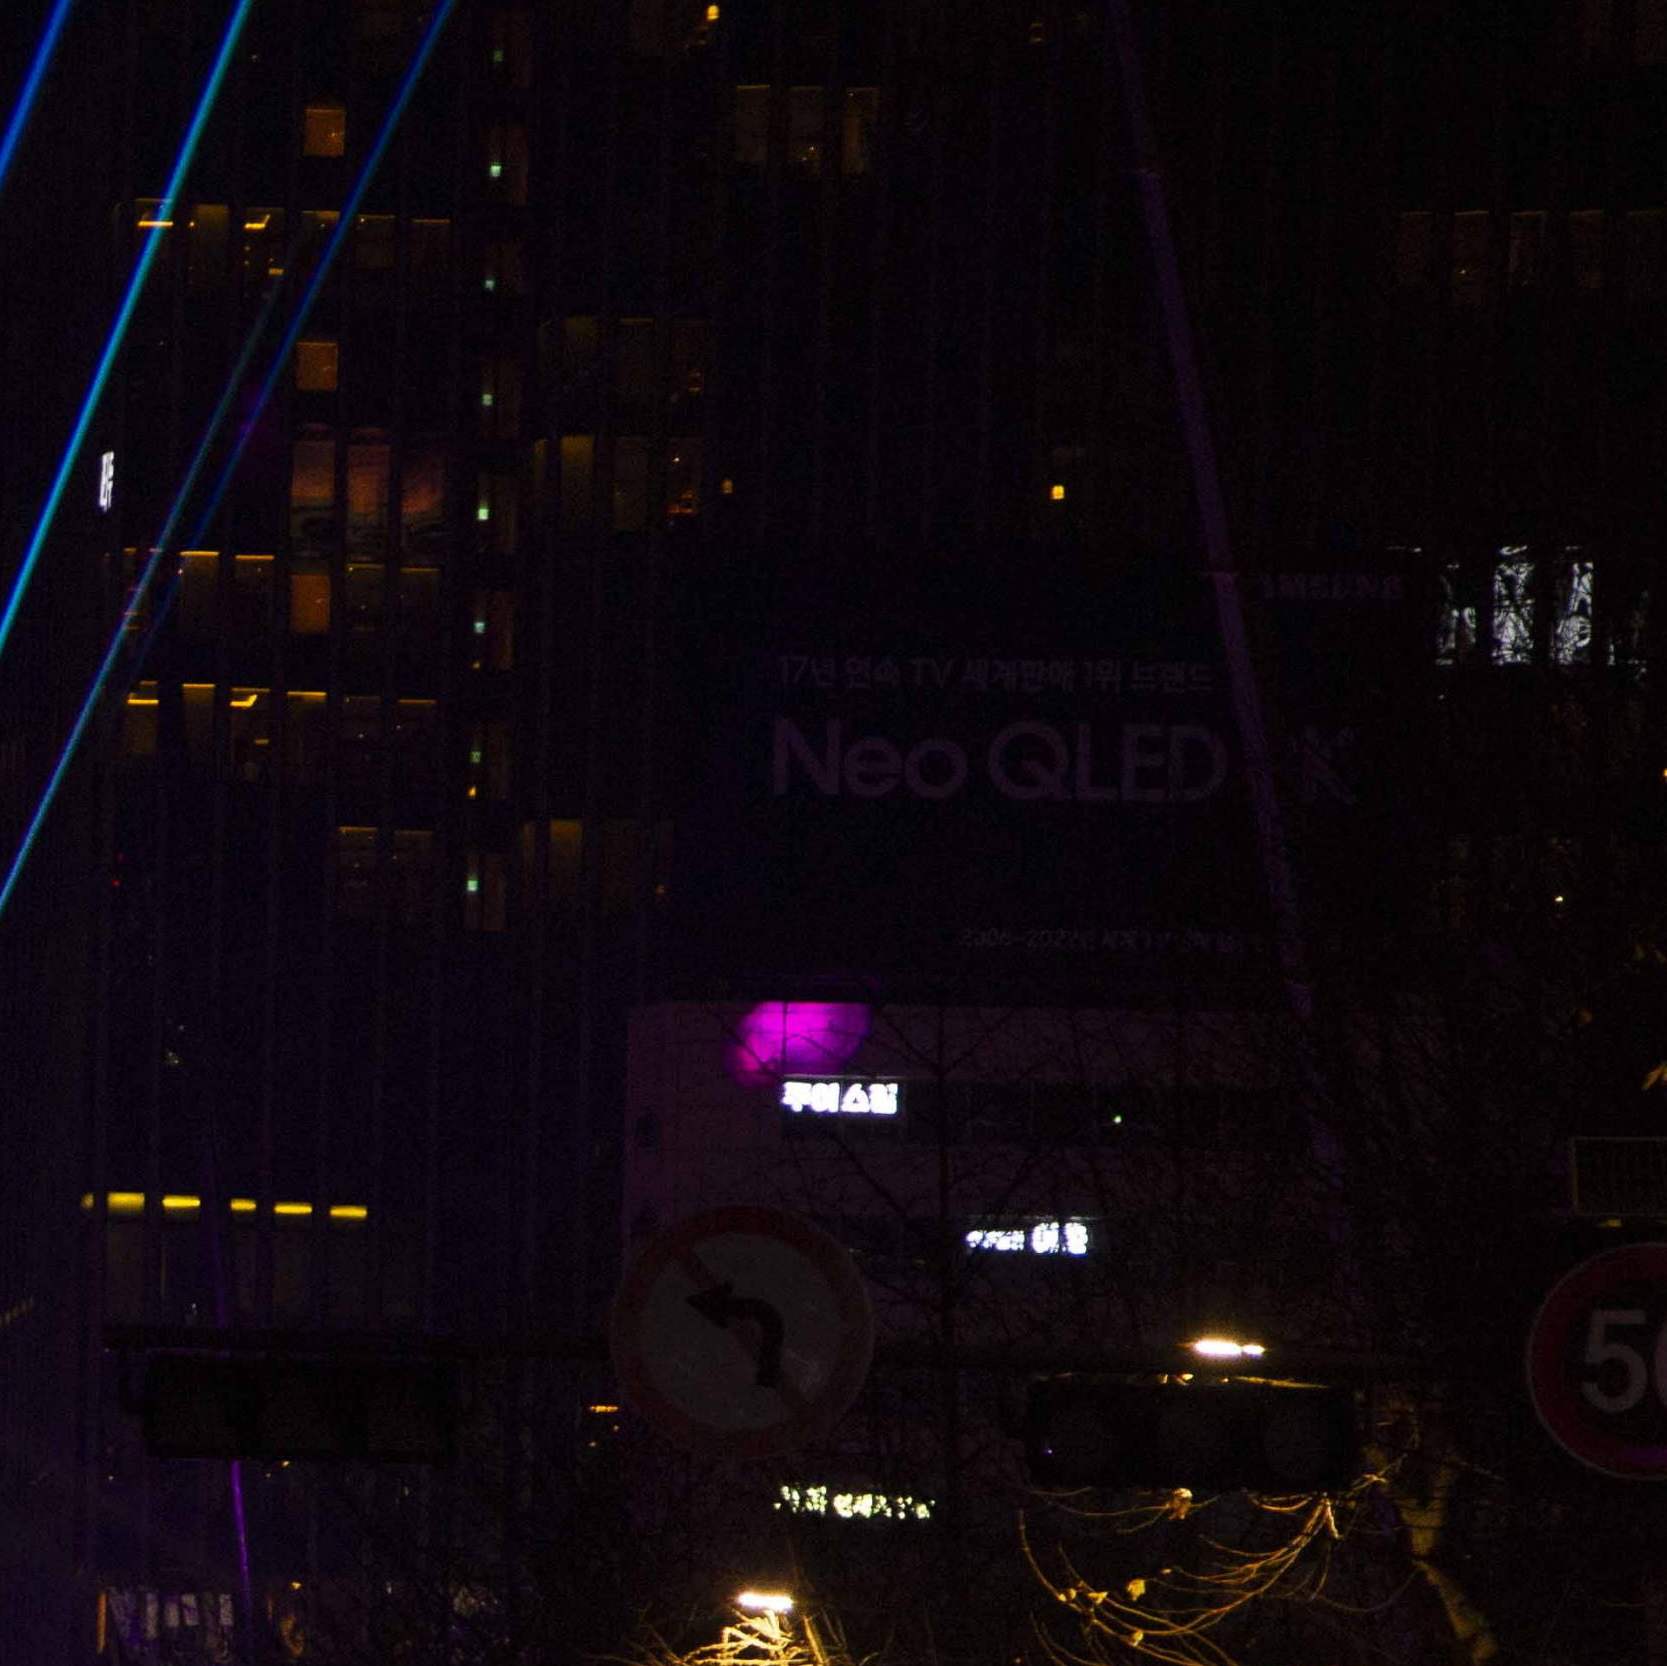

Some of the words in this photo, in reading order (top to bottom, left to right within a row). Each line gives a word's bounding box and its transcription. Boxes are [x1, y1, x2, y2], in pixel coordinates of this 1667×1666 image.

[910, 658, 953, 688] TV
[771, 715, 969, 800] Neo
[988, 719, 1229, 804] QLED
